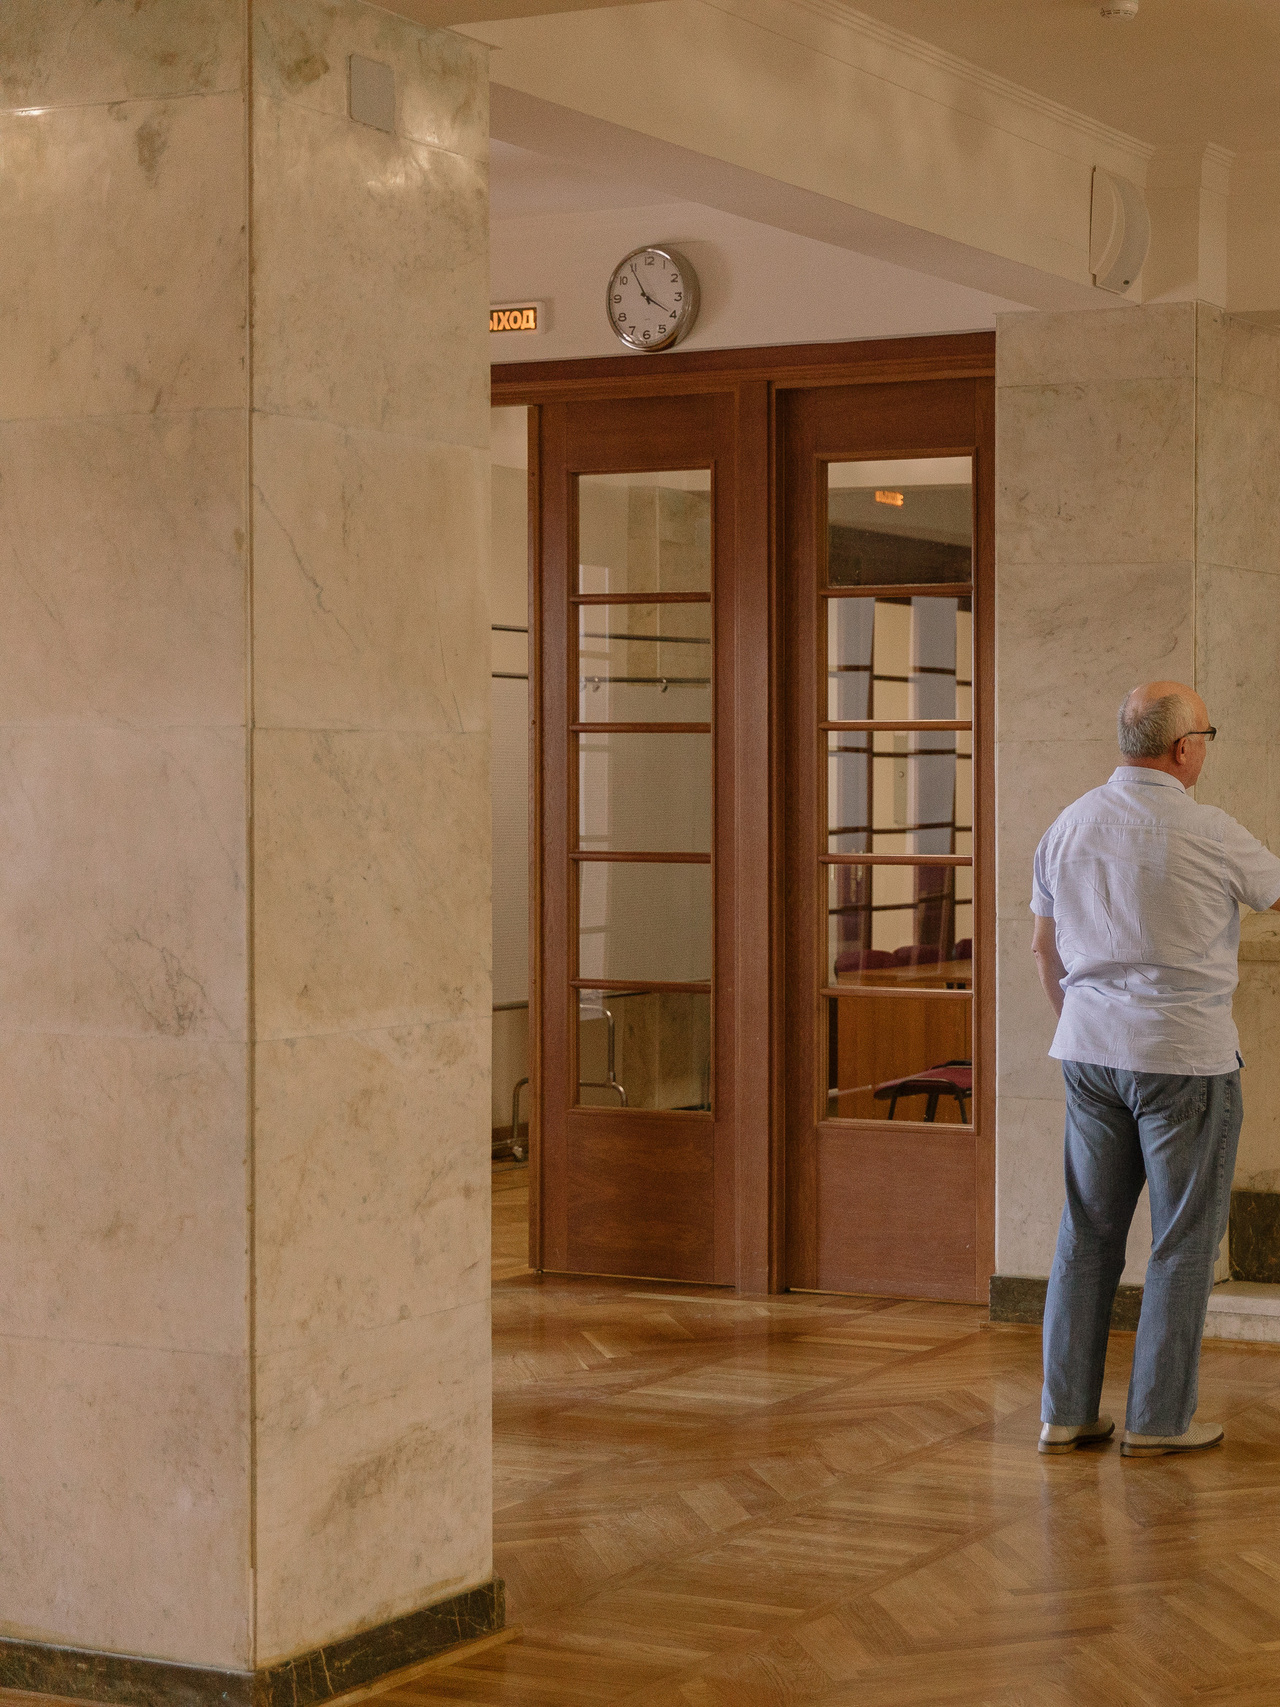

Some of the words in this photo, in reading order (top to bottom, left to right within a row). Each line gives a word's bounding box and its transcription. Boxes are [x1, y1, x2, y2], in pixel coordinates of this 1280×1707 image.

[644, 256, 655, 266] 12
[619, 276, 628, 286] 10
[670, 273, 679, 283] 2
[613, 294, 622, 304] 9
[674, 292, 682, 302] 3
[618, 312, 627, 322] 8
[669, 310, 677, 319] 4
[628, 326, 636, 336] 7
[658, 324, 667, 334] 5
[642, 330, 651, 340] 6
